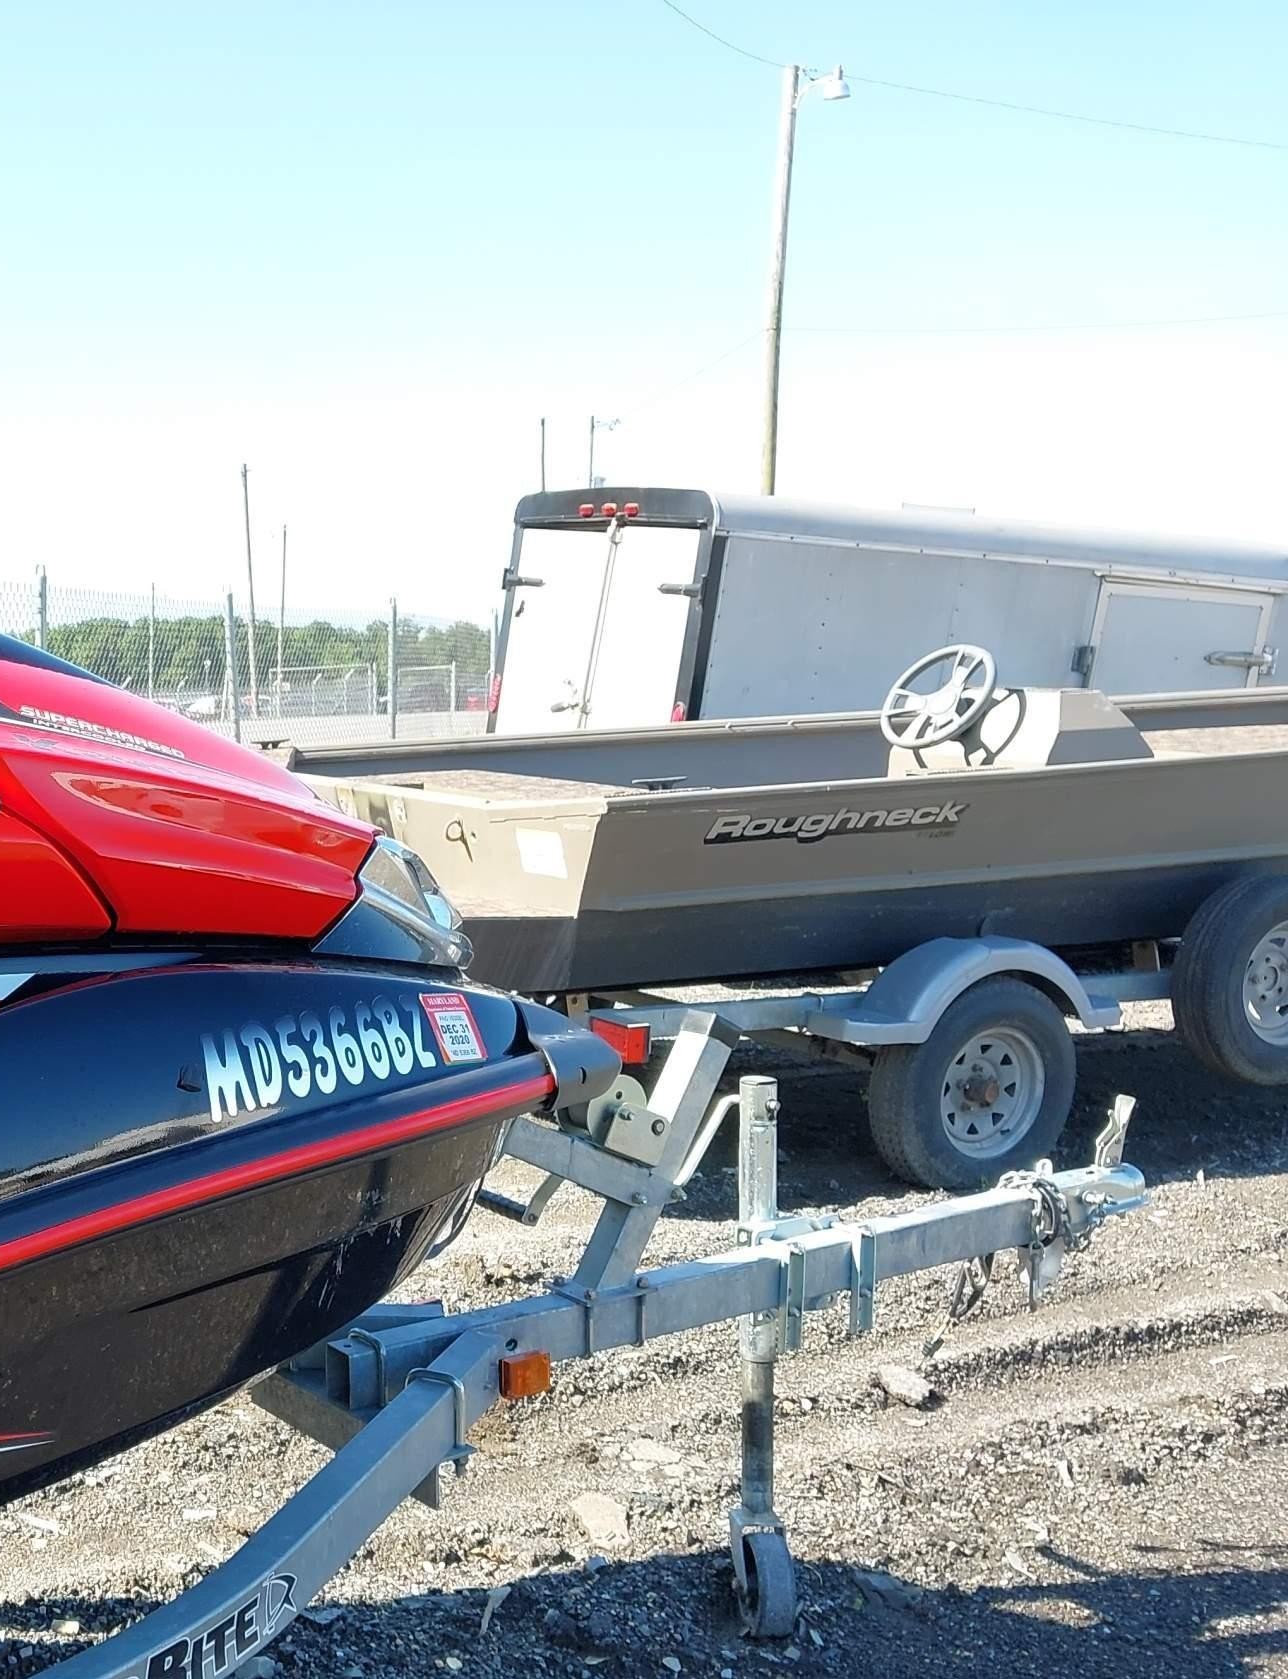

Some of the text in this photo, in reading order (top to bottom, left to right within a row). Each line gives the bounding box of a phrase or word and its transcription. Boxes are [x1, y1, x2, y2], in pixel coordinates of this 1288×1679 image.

[20, 705, 185, 759] SUPERCHARGED
[705, 801, 968, 841] Roughneck
[440, 1023, 470, 1034] DEC 31
[449, 1034, 471, 1045] 2020
[202, 995, 436, 1123] MD5366BZ
[146, 1592, 261, 1679] RITE
